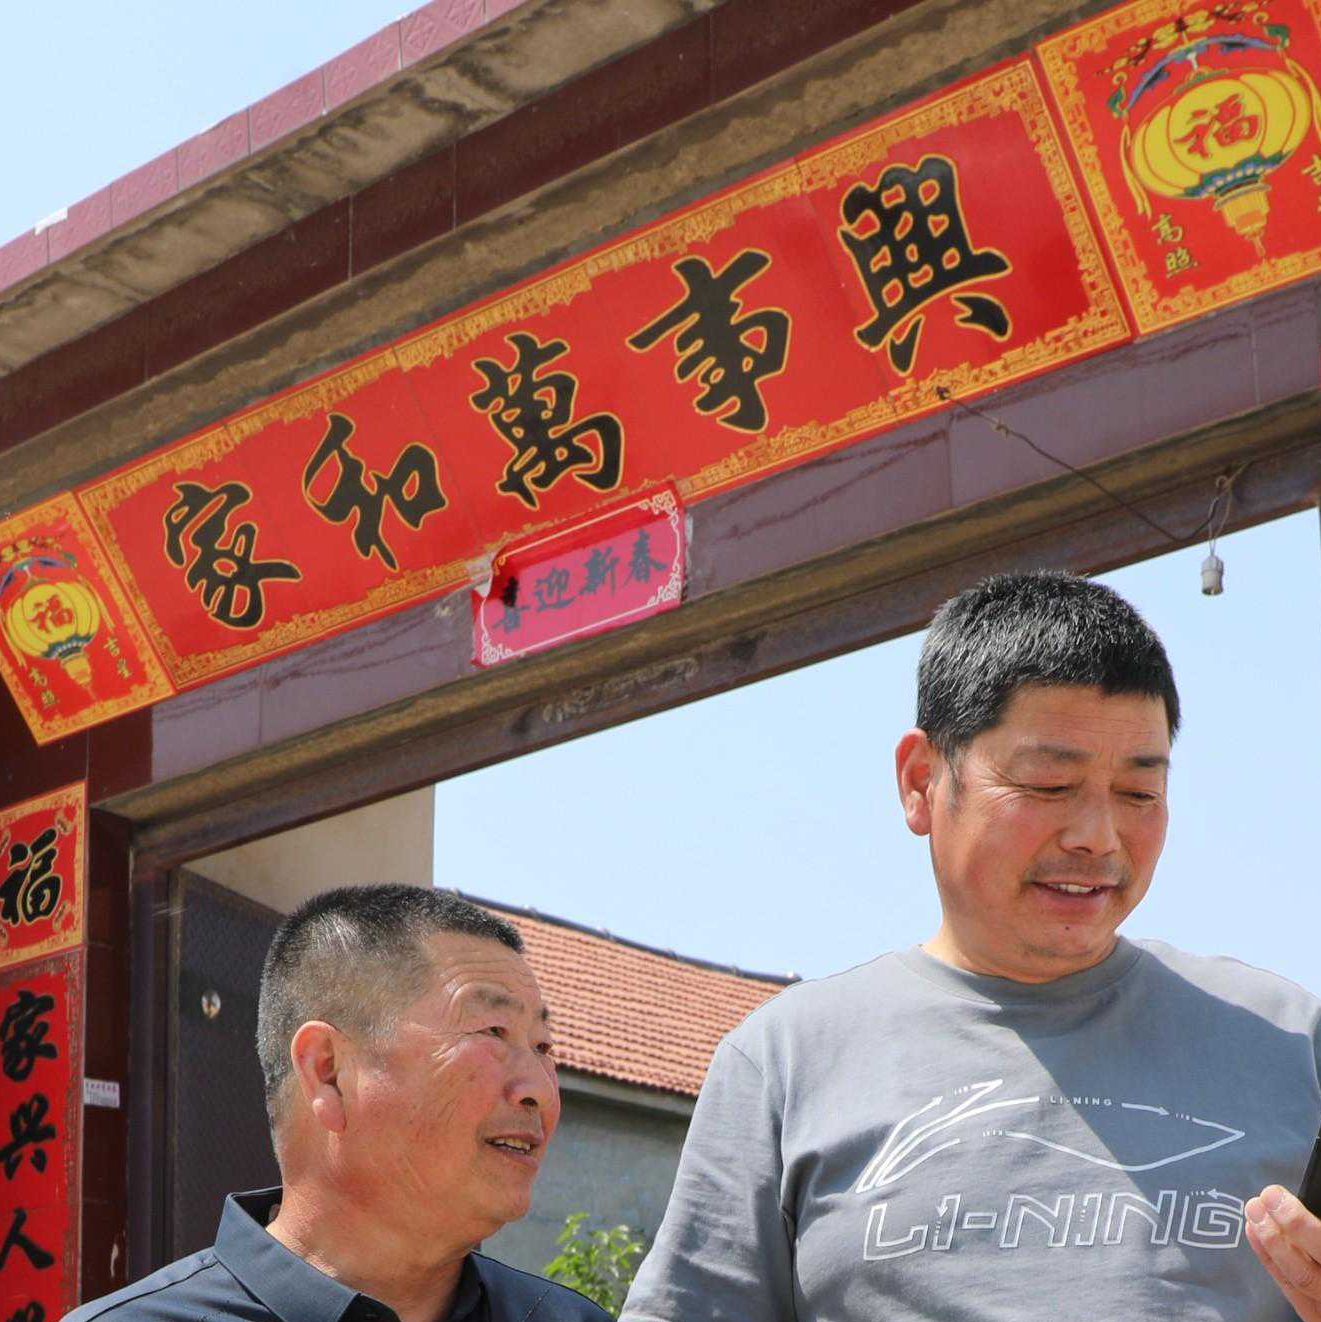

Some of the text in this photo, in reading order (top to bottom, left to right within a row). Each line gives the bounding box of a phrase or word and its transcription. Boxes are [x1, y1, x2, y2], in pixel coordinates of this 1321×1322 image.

[1174, 92, 1261, 160] 福
[493, 528, 669, 633] 喜迎新春
